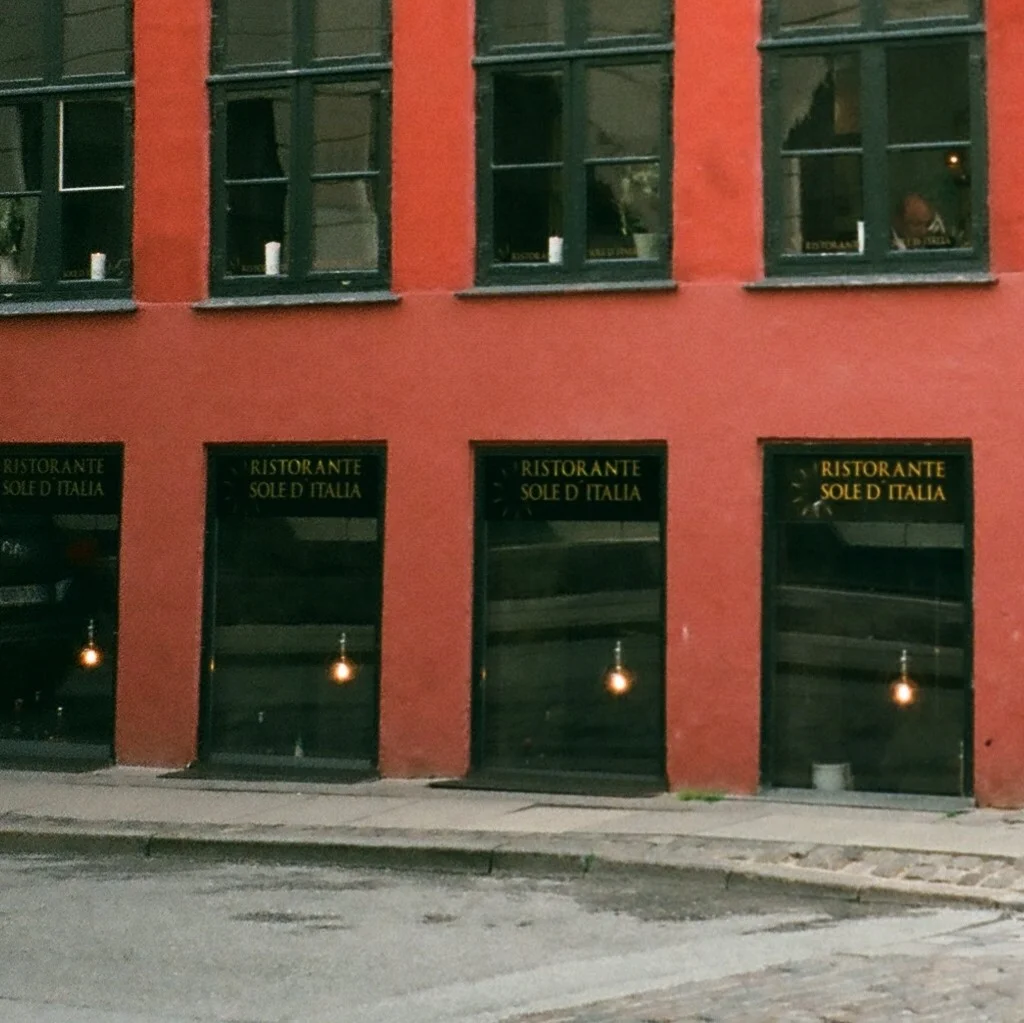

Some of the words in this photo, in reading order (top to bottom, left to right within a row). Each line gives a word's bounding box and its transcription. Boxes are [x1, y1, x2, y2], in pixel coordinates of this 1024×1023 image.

[3, 457, 105, 474] RISTORANTE
[250, 458, 362, 476] RISTORANTE
[521, 458, 642, 477] RISTORANTE
[820, 459, 946, 478] RISTORANTE
[2, 479, 36, 497] SOLE
[248, 480, 289, 499] SOLE
[520, 482, 561, 501] SOLE
[820, 483, 862, 501] SOLE
